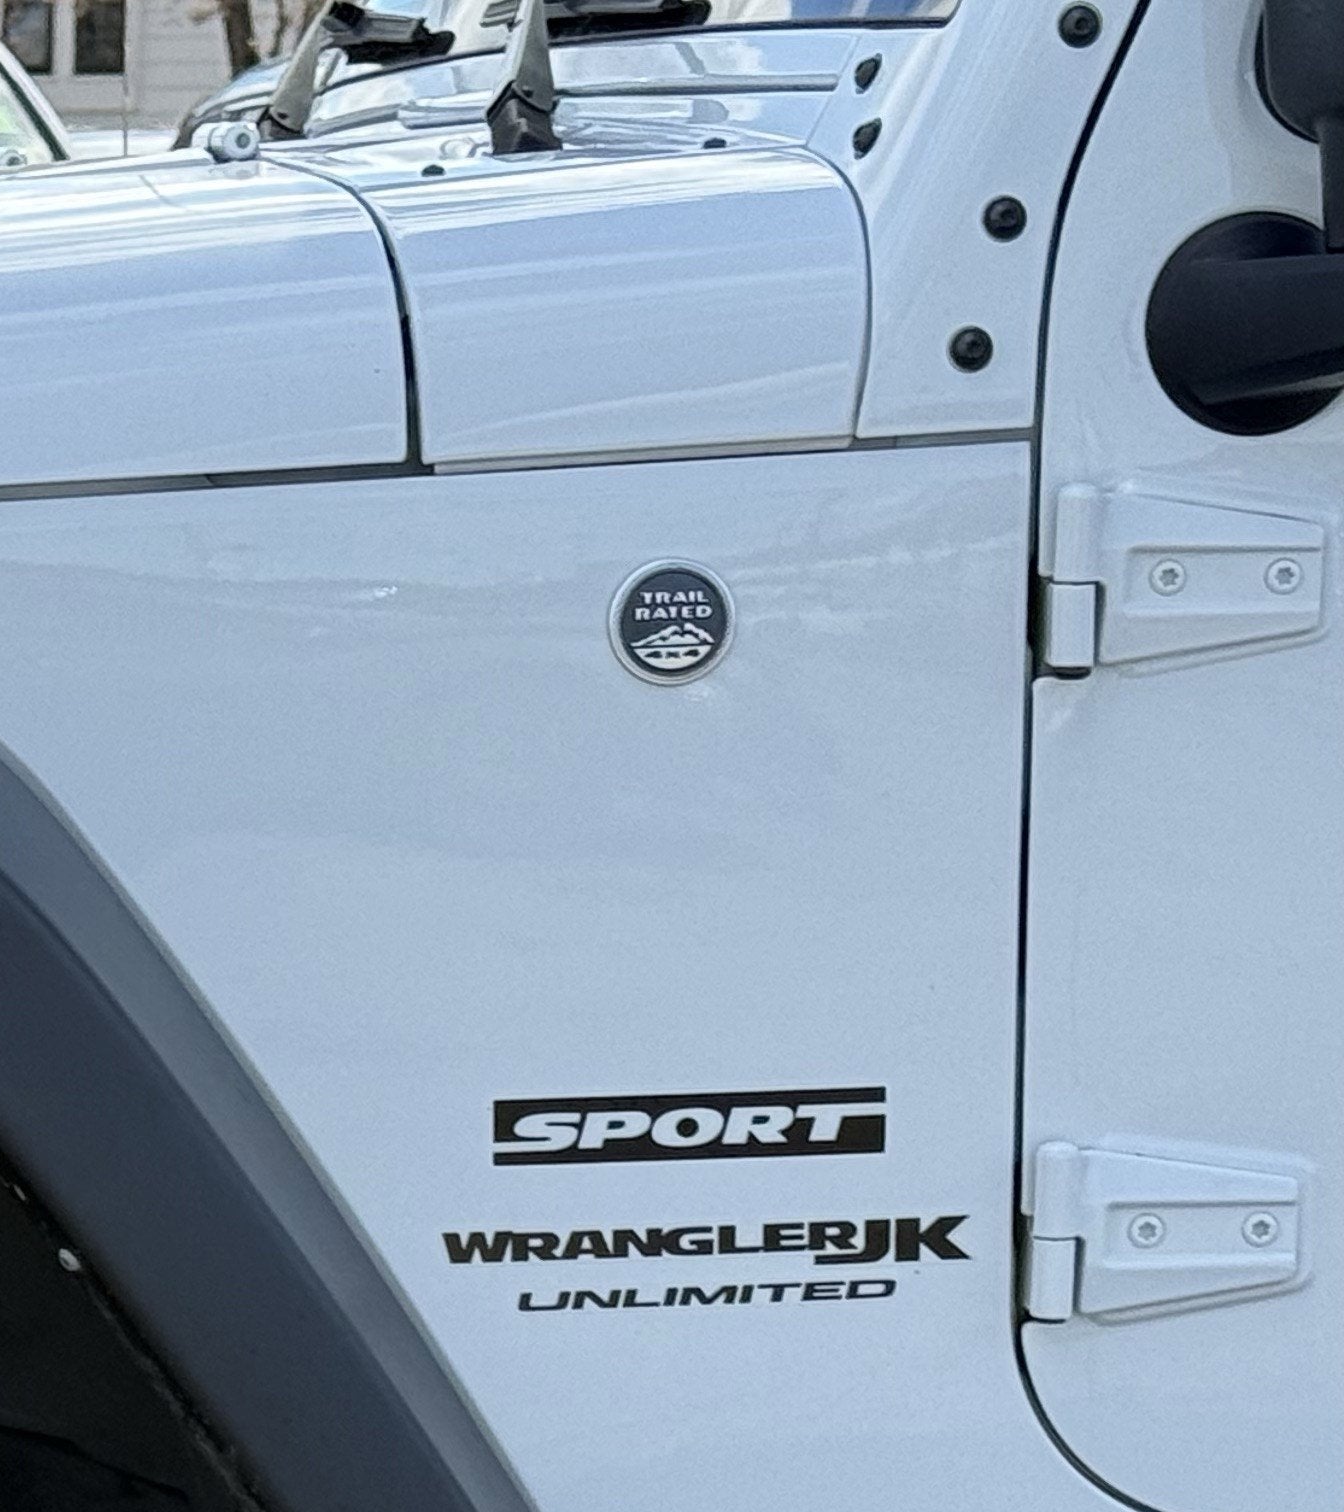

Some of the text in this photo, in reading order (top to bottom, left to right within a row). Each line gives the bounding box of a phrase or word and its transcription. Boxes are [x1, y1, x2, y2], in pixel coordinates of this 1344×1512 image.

[640, 590, 709, 605] TRAIL
[634, 604, 713, 621] RATED
[493, 1101, 886, 1153] SPORT
[517, 1279, 898, 1313] UNLIMITED
